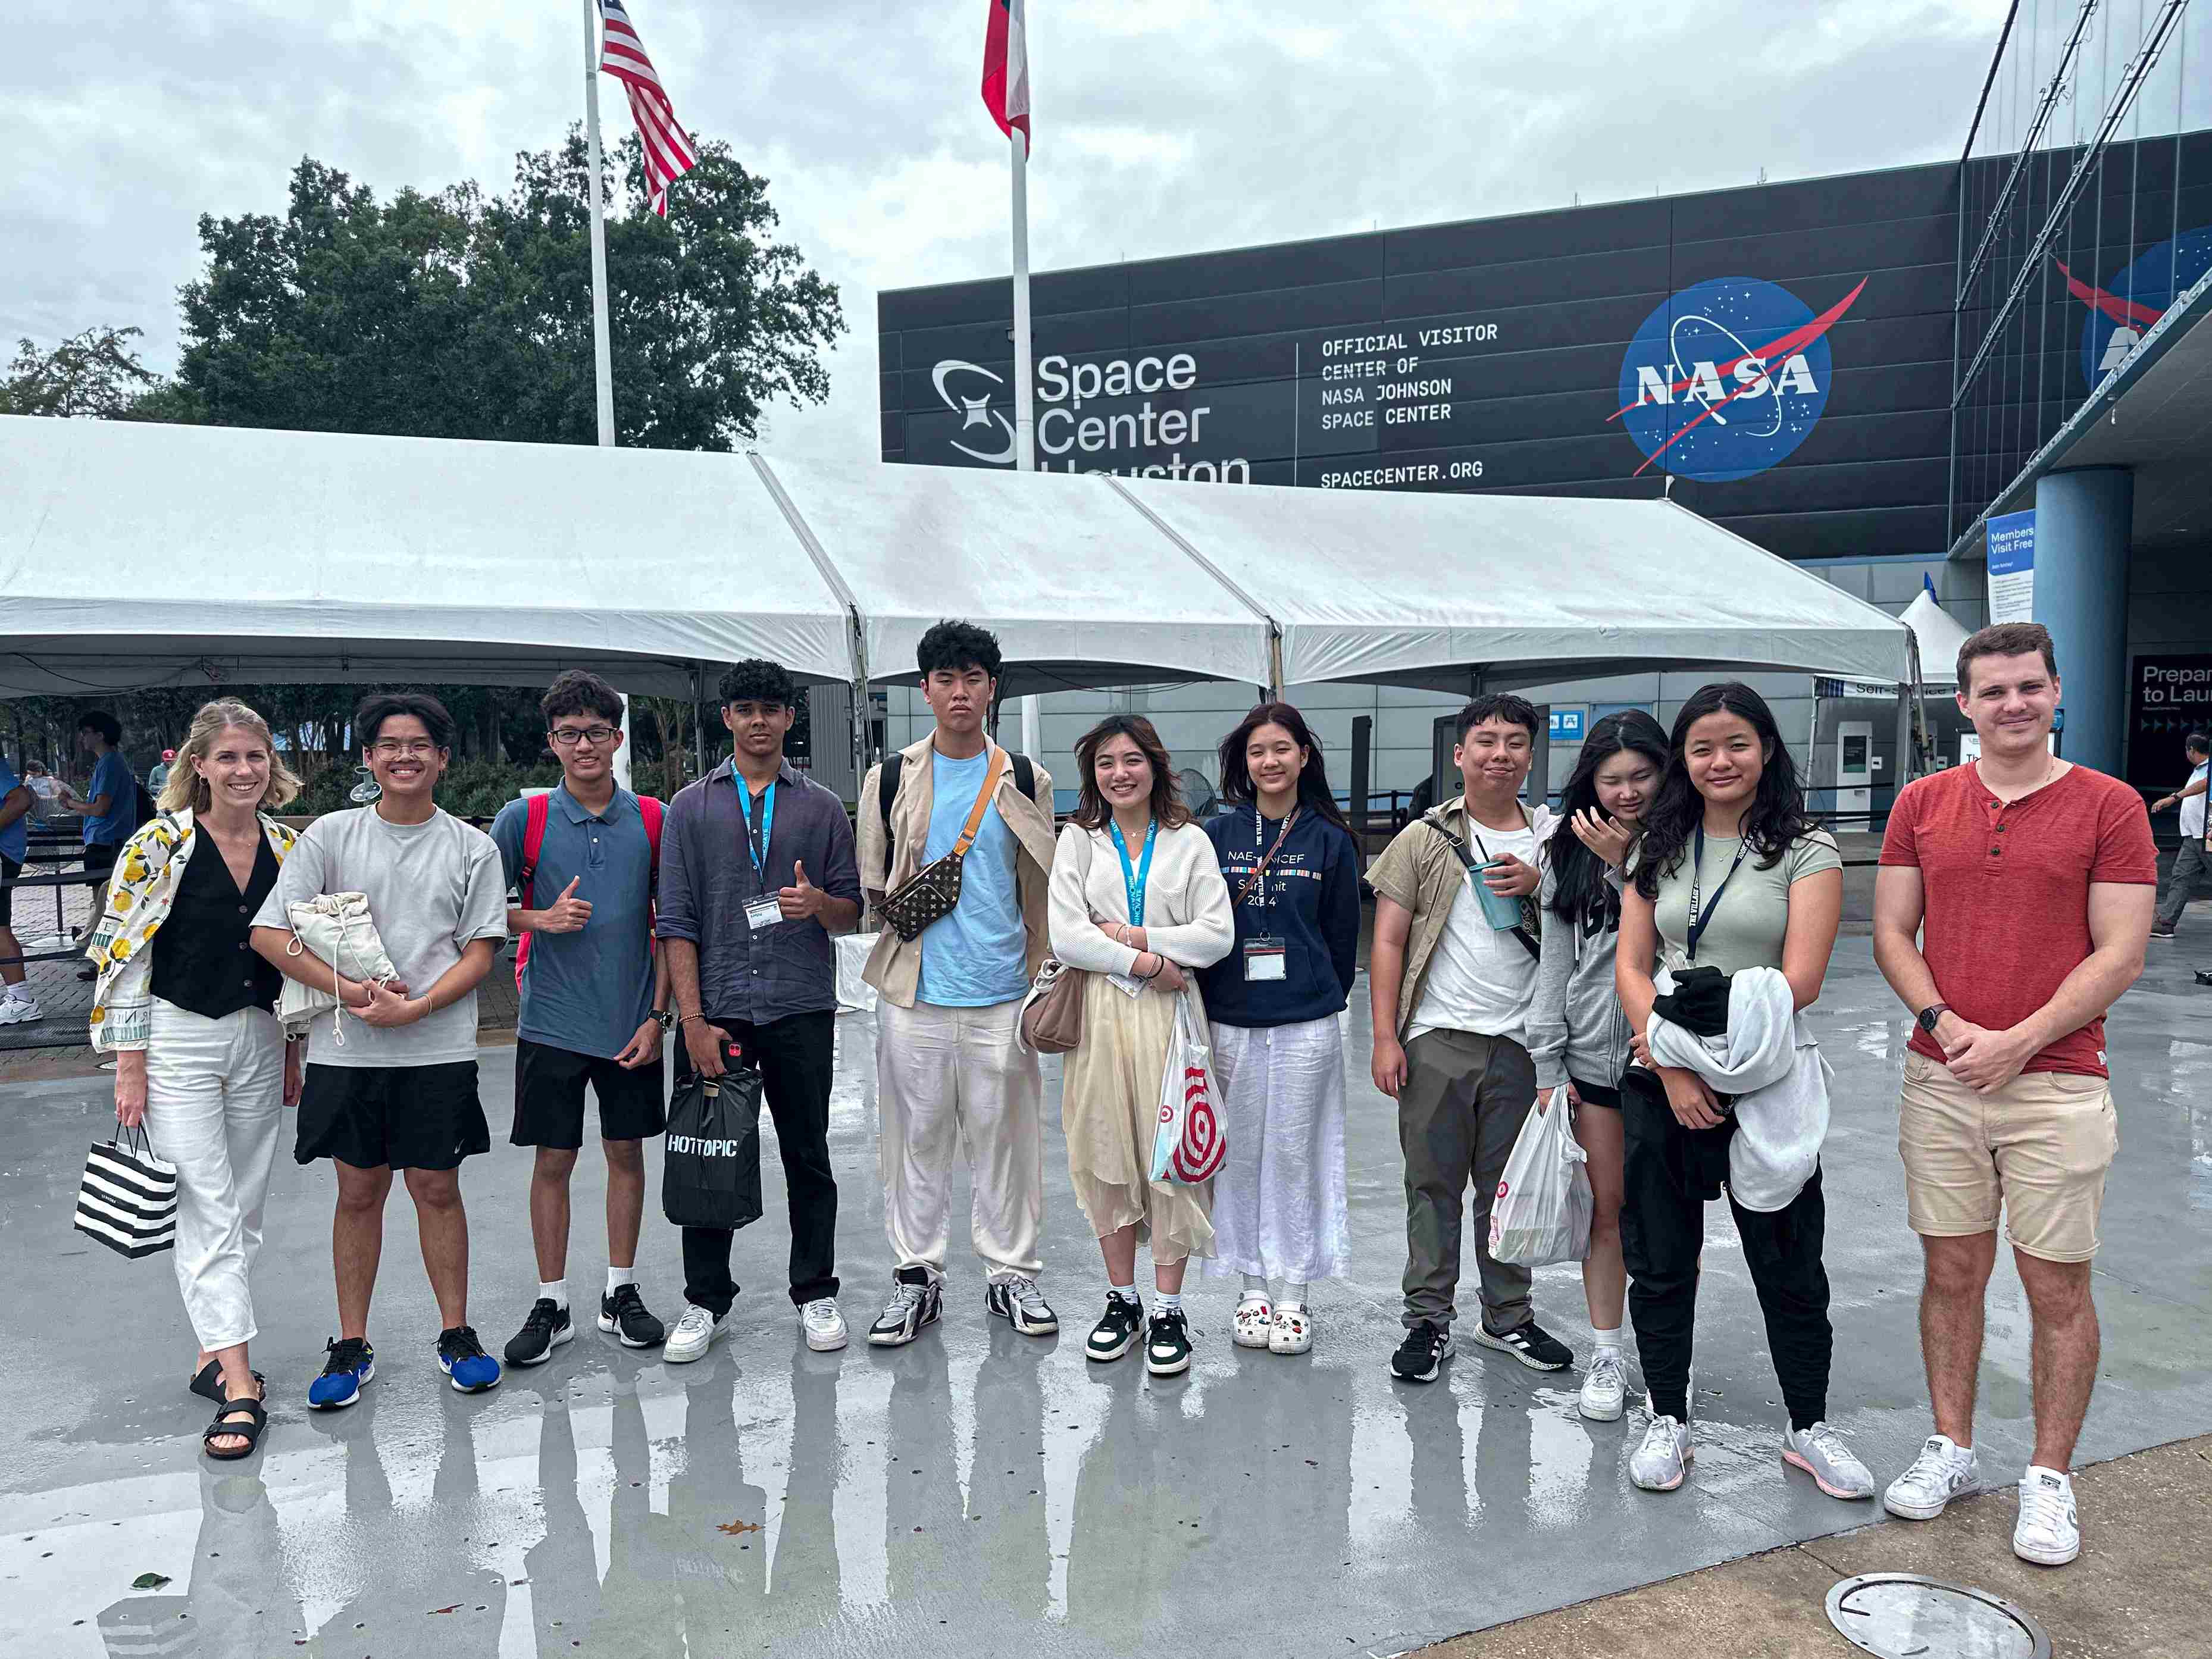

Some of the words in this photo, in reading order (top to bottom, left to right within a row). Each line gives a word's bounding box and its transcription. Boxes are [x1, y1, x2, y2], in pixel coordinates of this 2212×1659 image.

[1322, 333, 1408, 357] OFFICIAL
[1419, 324, 1498, 346] VISITOR
[1037, 353, 1196, 410] Space
[1322, 361, 1386, 381] CENTER
[1397, 357, 1419, 374] OF
[1636, 354, 1819, 406] NASA
[1322, 387, 1365, 406] NASA
[1376, 378, 1452, 400] JOHNSON
[1038, 402, 1210, 455] Center
[1322, 411, 1374, 430] SPACE
[1385, 404, 1451, 424] CENTER
[1321, 461, 1484, 489] SPACECENTER.ORG
[1991, 527, 2034, 543] Members
[1991, 541, 2012, 555] Visit
[2014, 539, 2033, 550] Free
[2143, 666, 2212, 685] Prepar
[2143, 686, 2164, 702] to
[2170, 685, 2212, 702] Lau
[1690, 888, 1699, 914] VILLAGE
